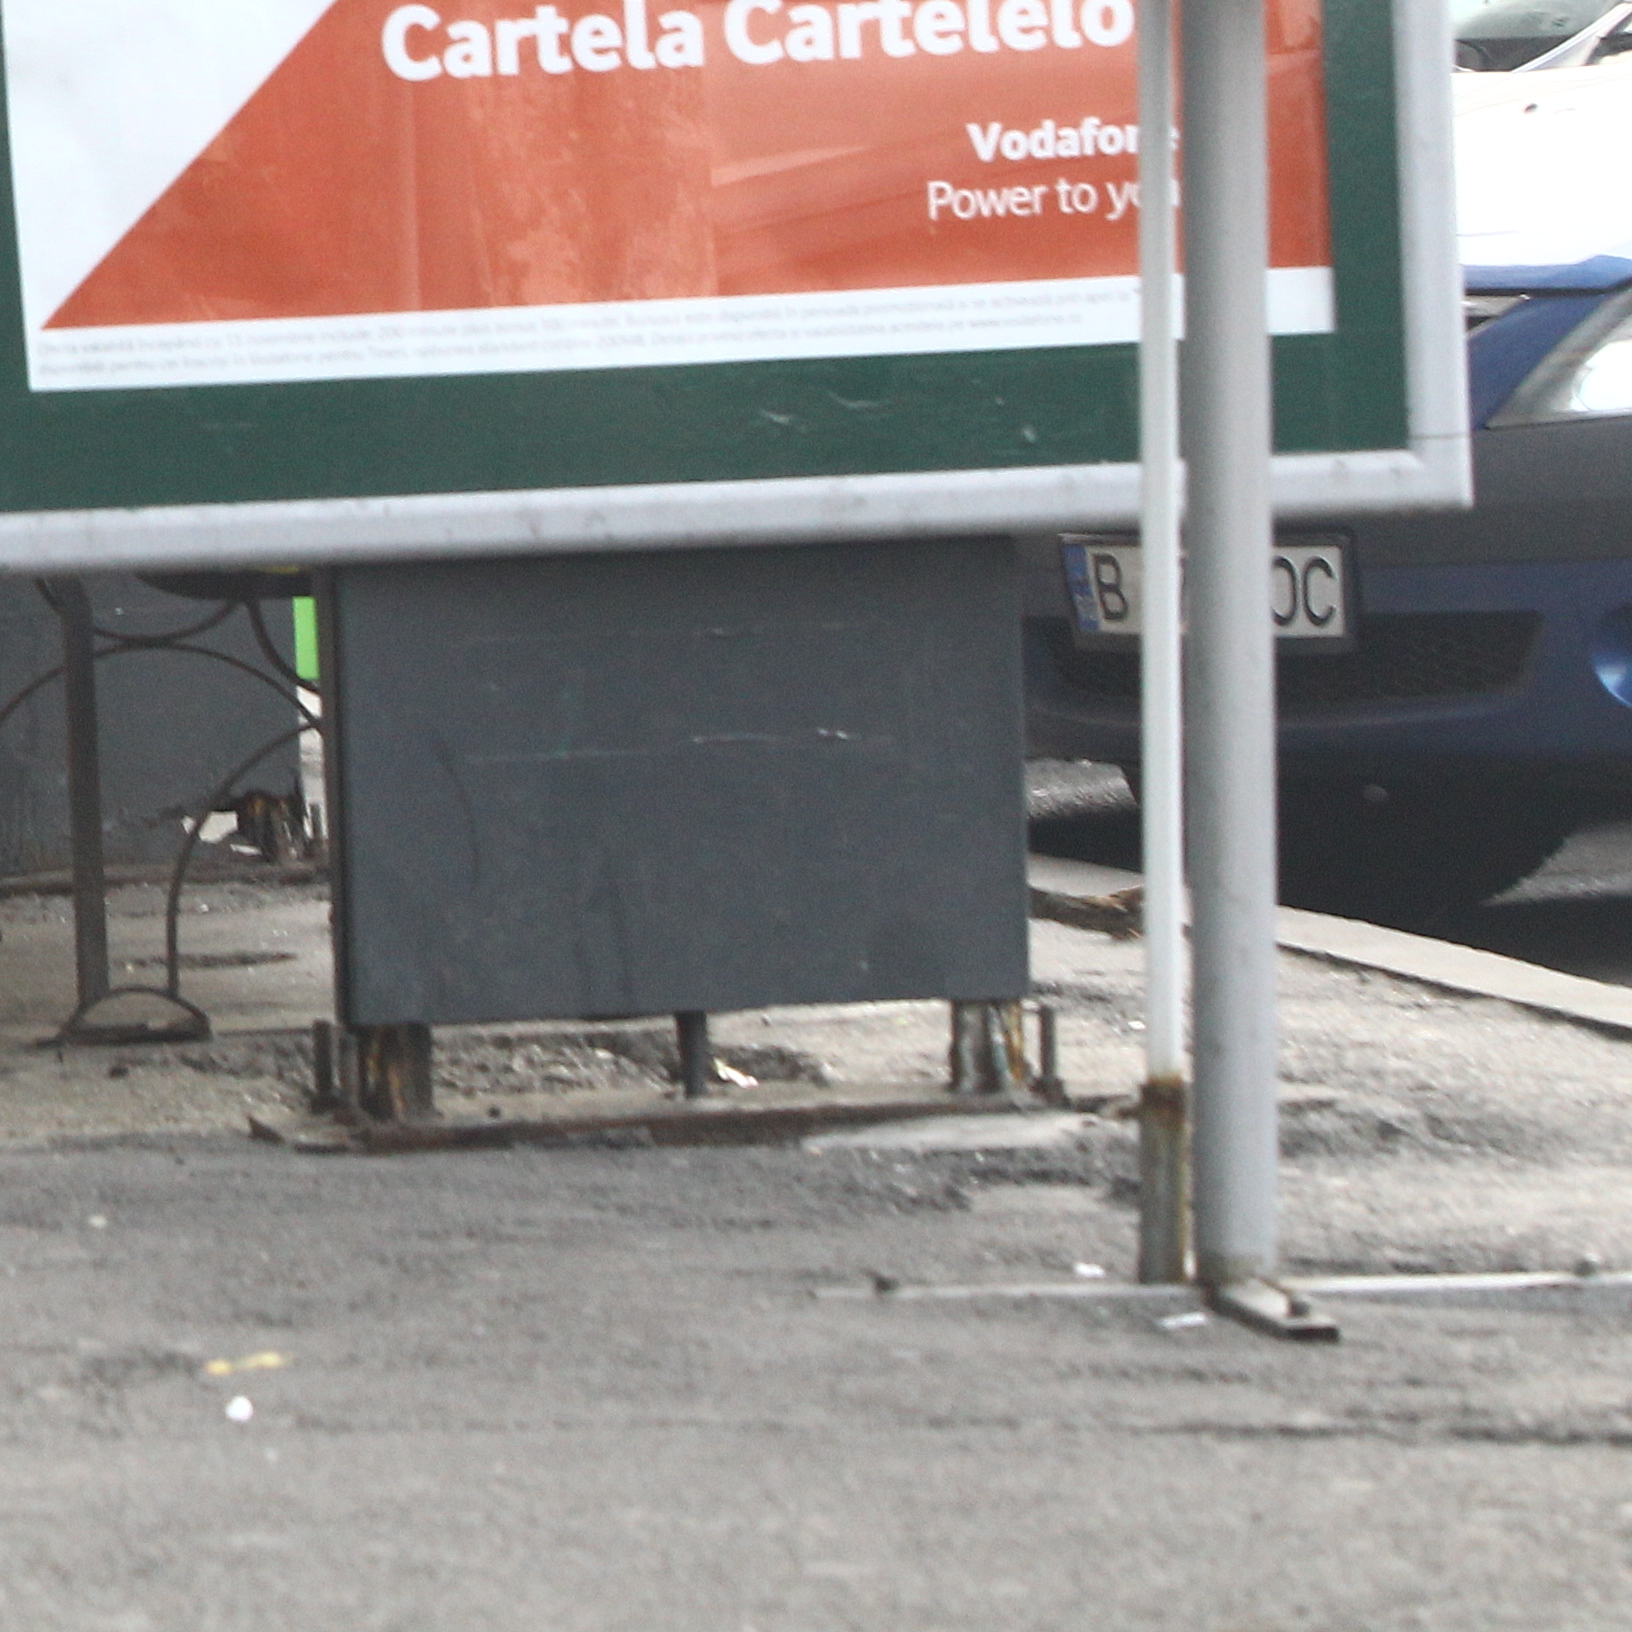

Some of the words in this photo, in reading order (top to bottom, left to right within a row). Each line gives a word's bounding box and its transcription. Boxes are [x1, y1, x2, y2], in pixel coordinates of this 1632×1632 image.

[926, 179, 1048, 221] Power
[1054, 178, 1098, 214] to
[1091, 552, 1129, 621] B
